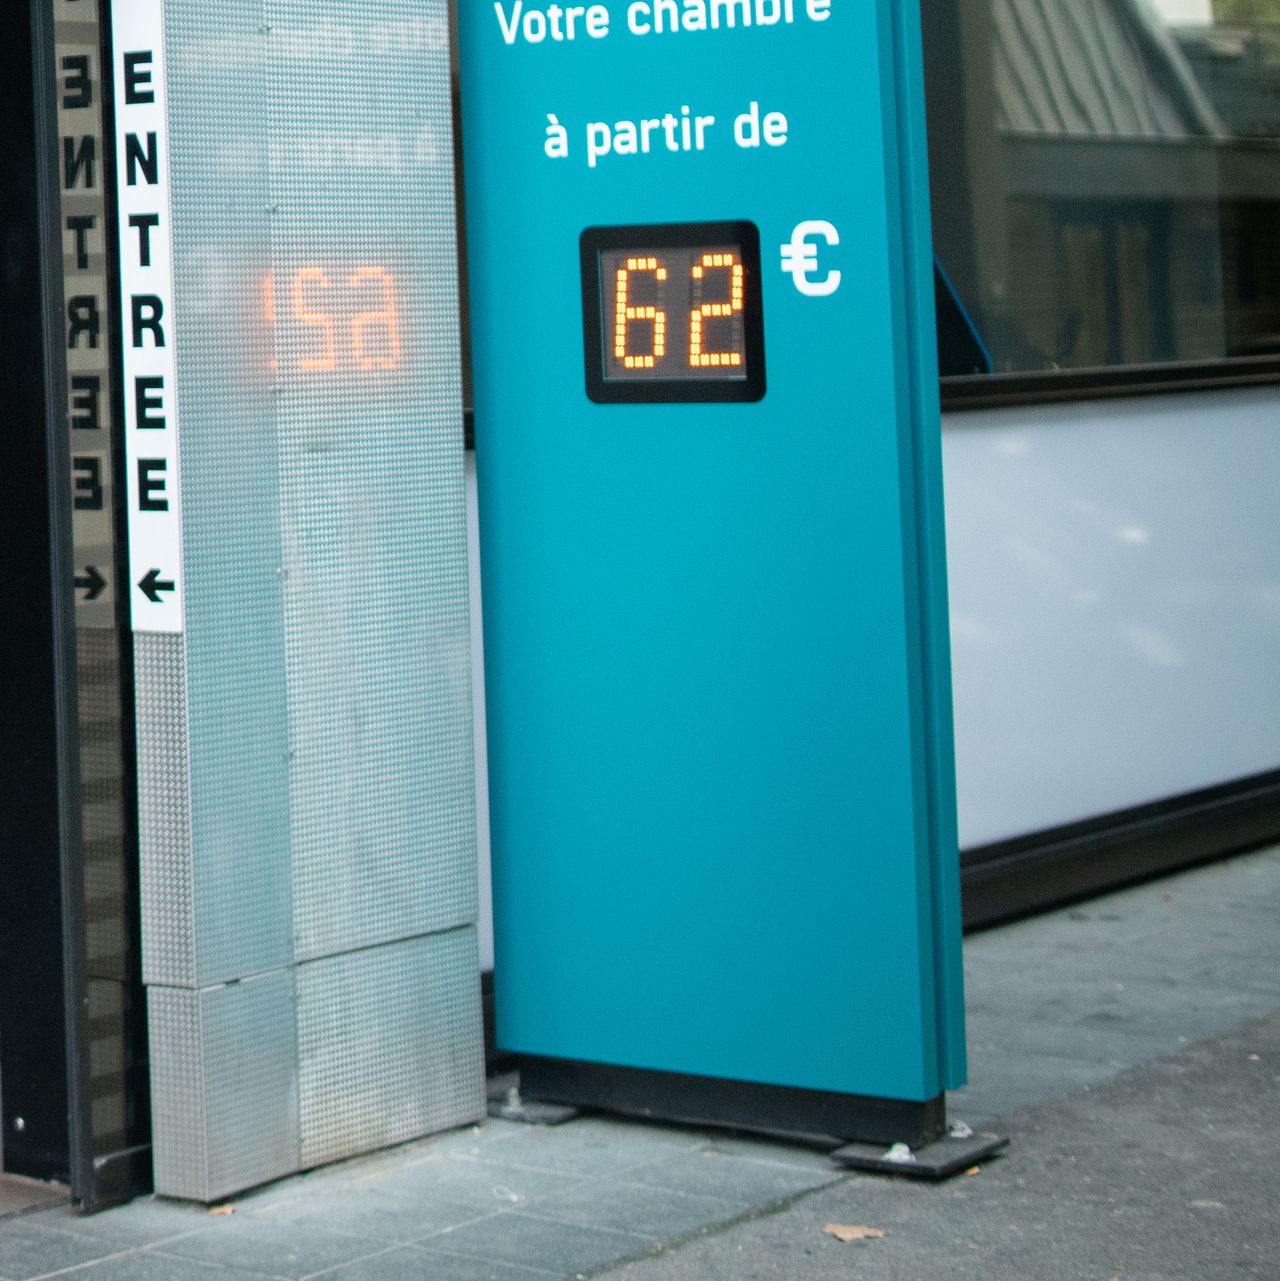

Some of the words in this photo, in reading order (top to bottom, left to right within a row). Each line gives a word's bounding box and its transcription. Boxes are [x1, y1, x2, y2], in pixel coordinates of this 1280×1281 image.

[493, 0, 610, 45] Votre
[543, 113, 569, 158] à
[586, 105, 715, 167] partir
[733, 101, 789, 148] de
[123, 49, 169, 511] ENTREE
[614, 253, 743, 368] 62
[780, 219, 842, 297] €
